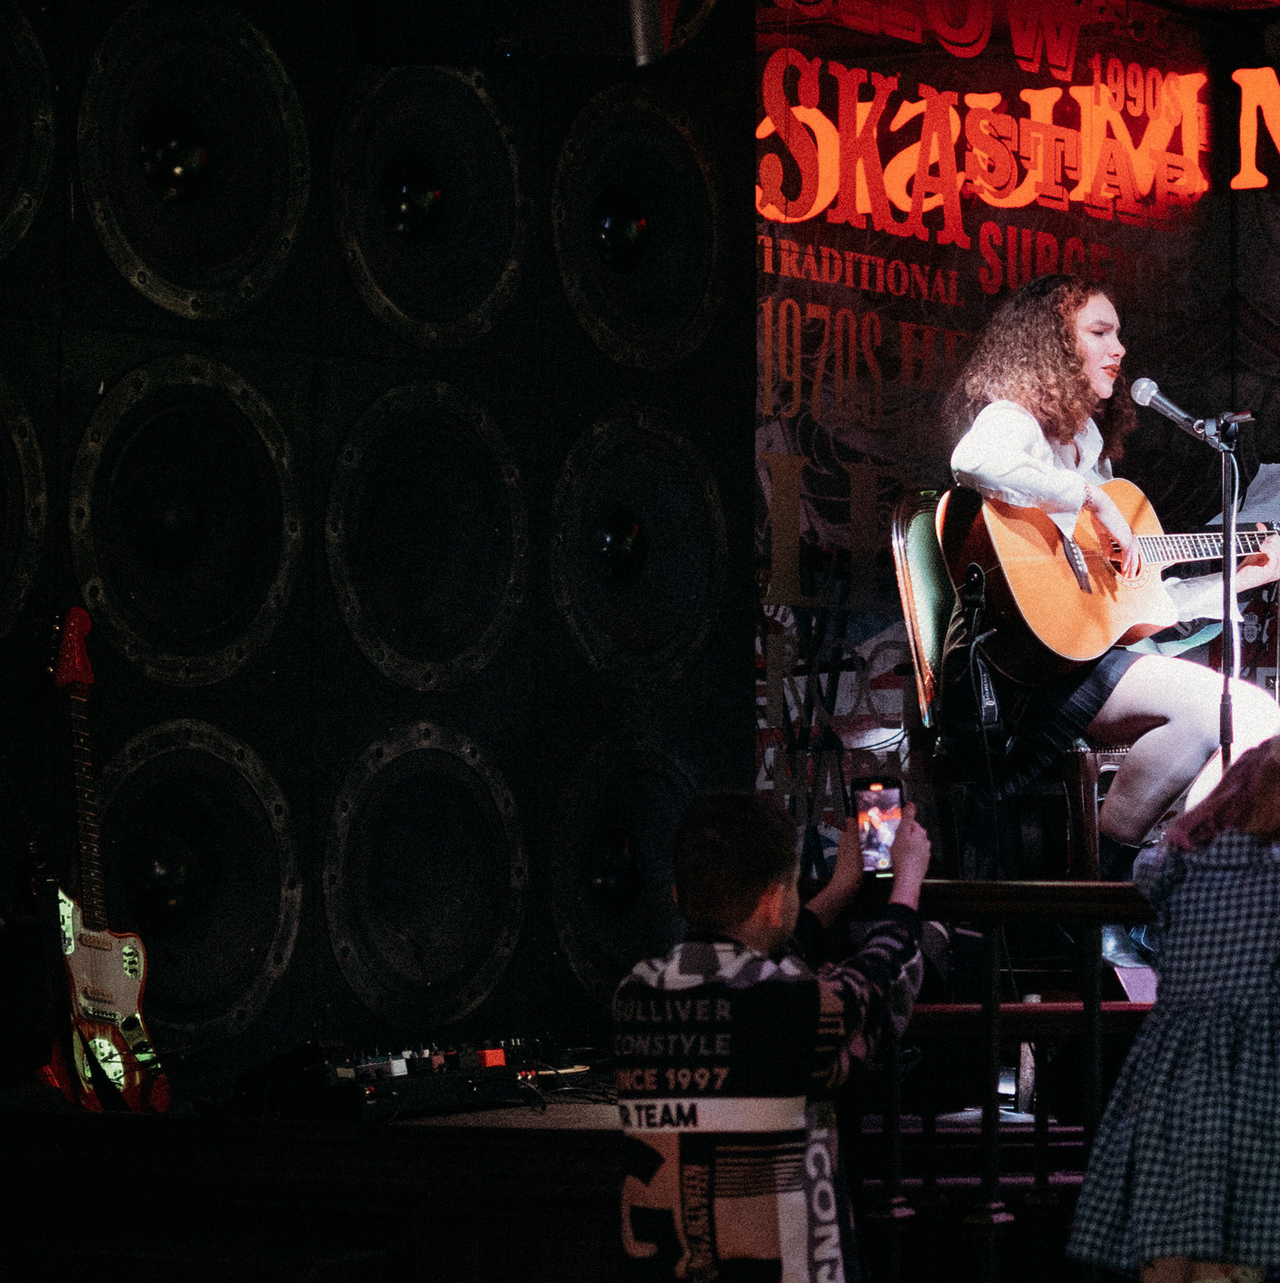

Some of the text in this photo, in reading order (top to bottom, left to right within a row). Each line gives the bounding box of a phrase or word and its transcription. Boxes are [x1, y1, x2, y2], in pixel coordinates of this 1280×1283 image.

[757, 46, 972, 251] SKA
[757, 235, 964, 307] TRADITIONAL
[664, 1065, 731, 1091] 1997
[634, 1103, 698, 1127] TEAM
